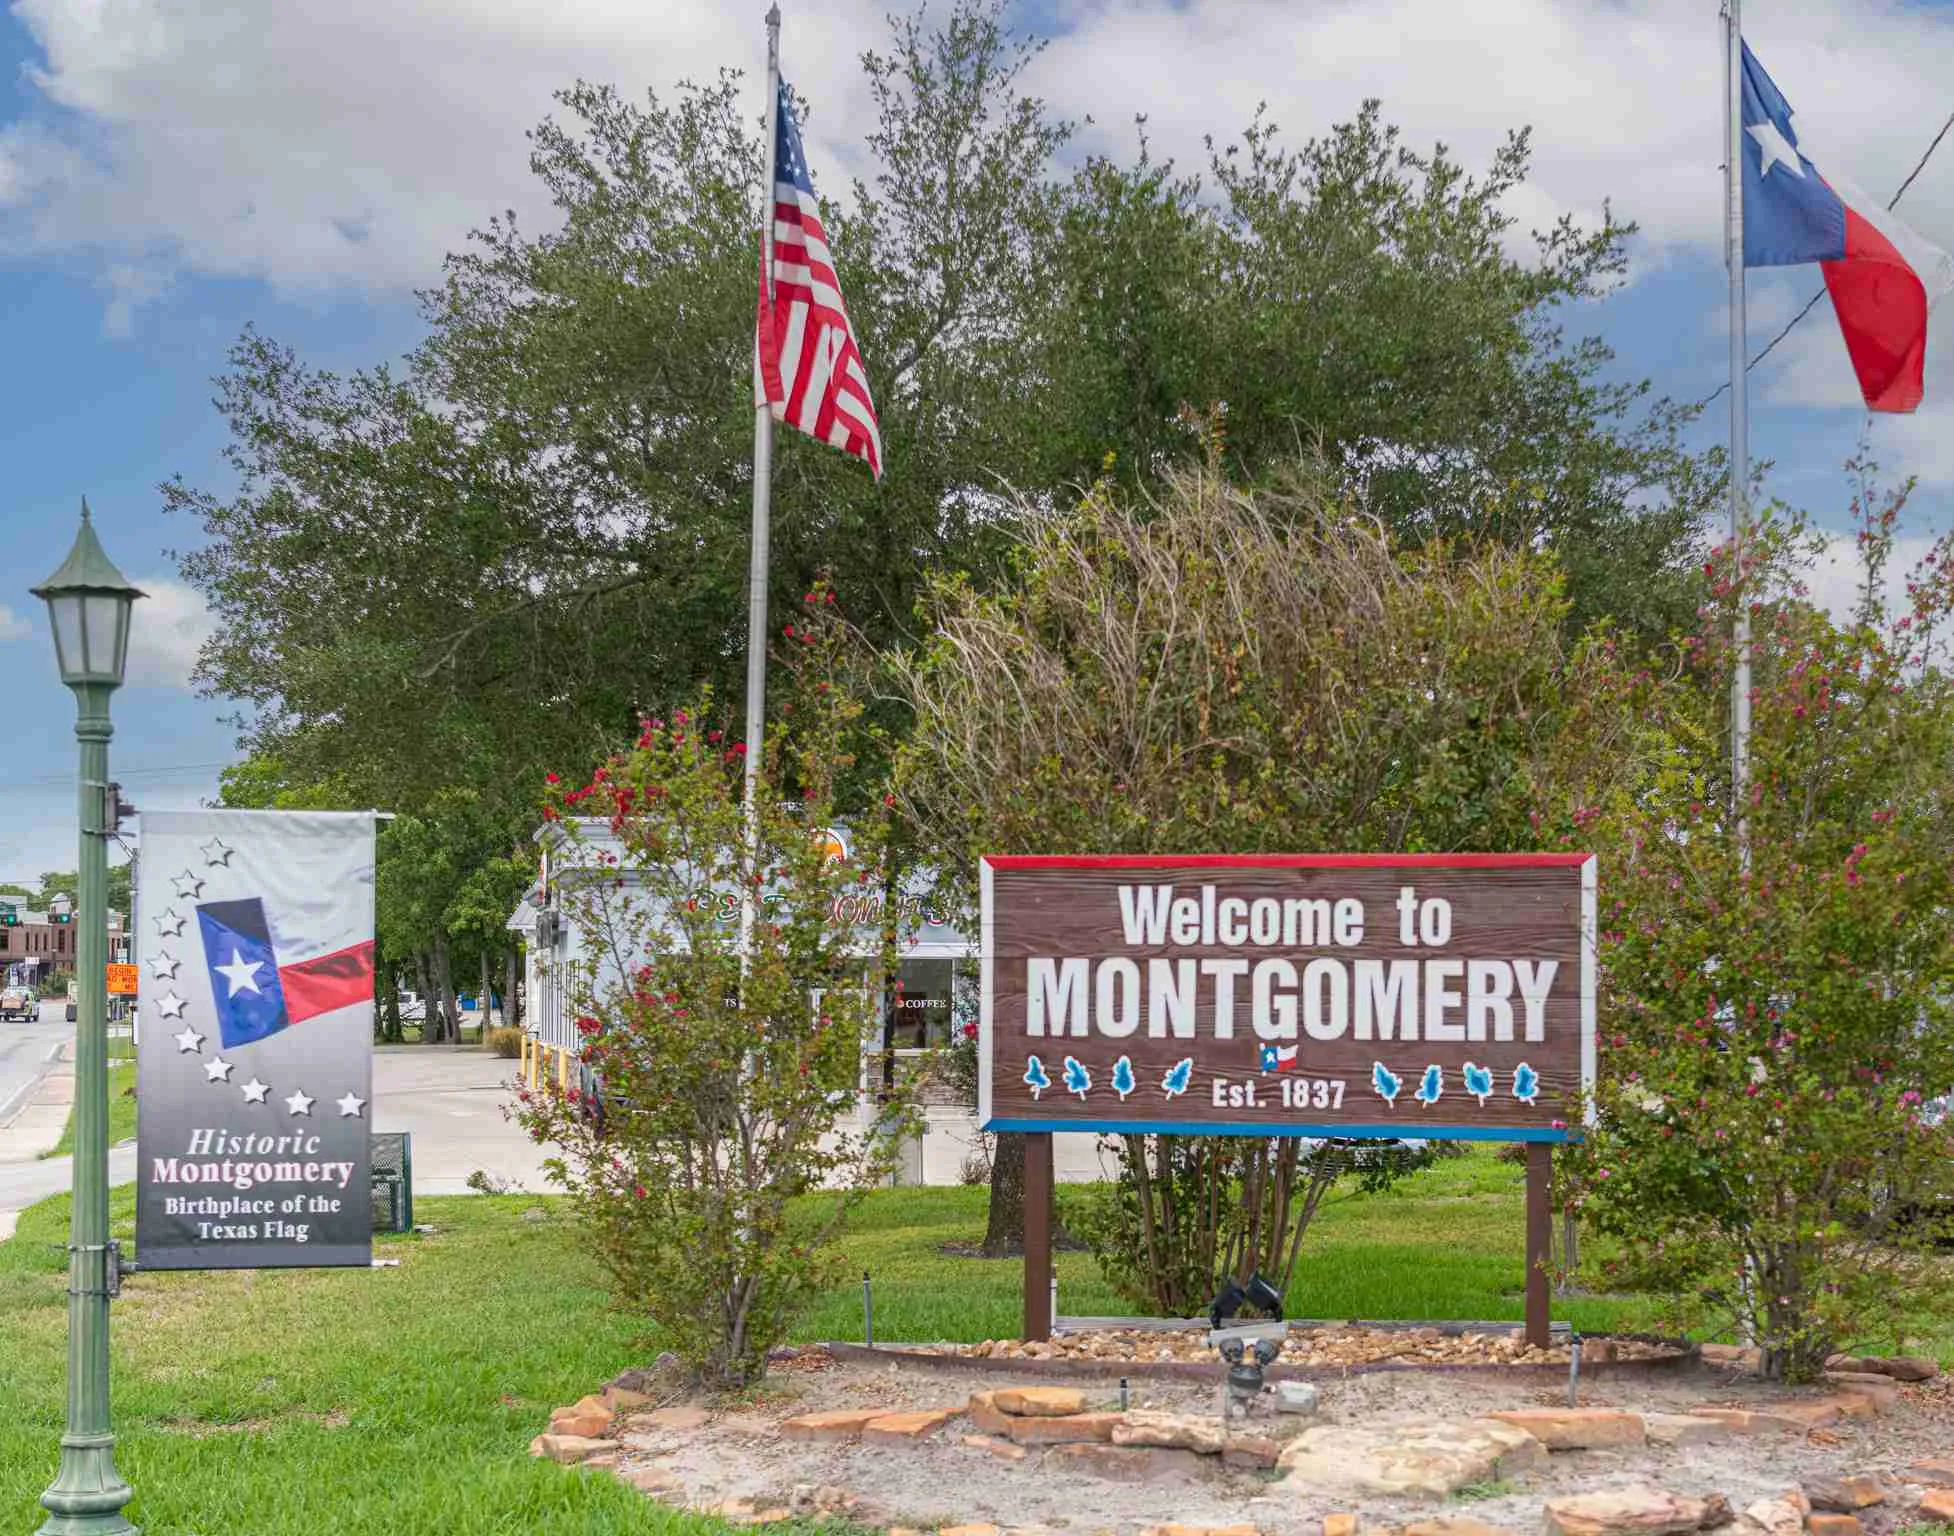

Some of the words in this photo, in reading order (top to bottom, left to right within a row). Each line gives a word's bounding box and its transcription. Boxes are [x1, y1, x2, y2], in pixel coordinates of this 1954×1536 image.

[1118, 885, 1365, 946] Welcome
[1396, 886, 1452, 946] to
[905, 999, 947, 1009] COFFEE
[1026, 956, 1559, 1042] MONTGOMERY
[1212, 1078, 1267, 1108] Est.
[1279, 1078, 1346, 1109] 1837
[186, 1128, 321, 1155] Historic
[152, 1157, 355, 1190] Montgomery
[165, 1196, 275, 1219] Birthplace
[281, 1194, 306, 1213] of
[308, 1195, 342, 1213] the
[198, 1221, 258, 1240] Texas
[263, 1220, 310, 1242] Flag
